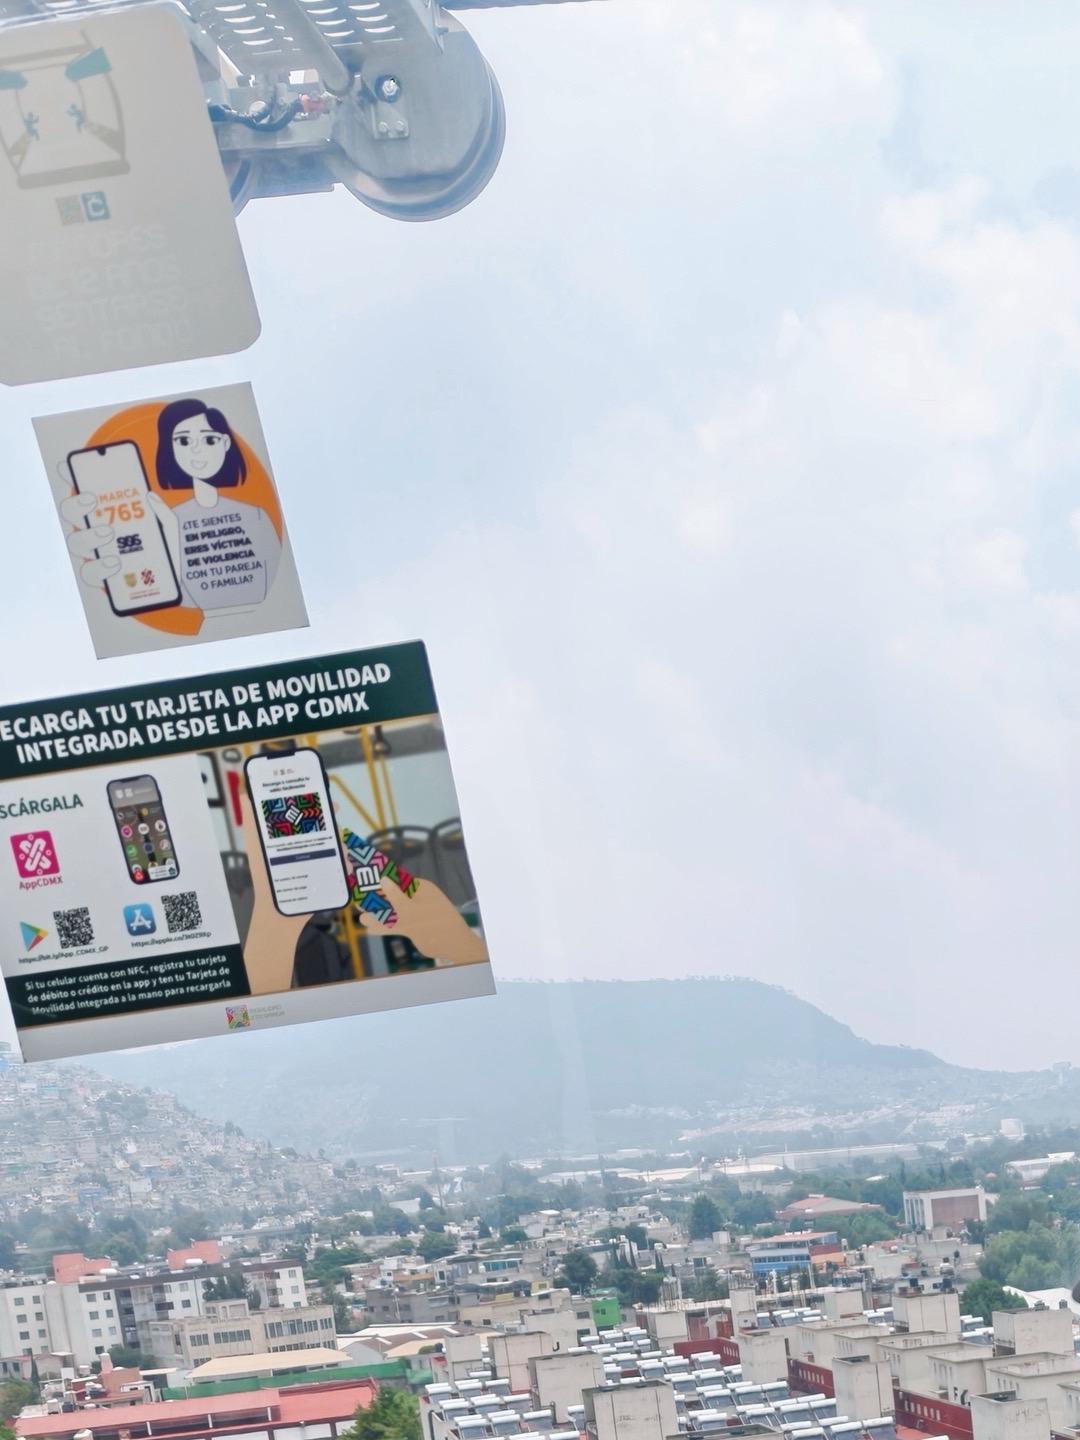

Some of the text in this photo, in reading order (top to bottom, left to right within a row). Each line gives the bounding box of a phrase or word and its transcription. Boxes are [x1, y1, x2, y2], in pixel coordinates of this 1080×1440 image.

[97, 487, 140, 503] MARCA
[183, 513, 242, 531] ¿TE SIENTES
[185, 526, 245, 542] EN PELIGRO,
[184, 537, 252, 555] ERES VÍCTIMA
[187, 549, 255, 567] DE VIOLENCIA
[186, 560, 262, 580] CON TU PAREJA
[200, 574, 254, 591] O FAMILIA?
[0, 663, 391, 742] ECARGA TU TARJETA DE MOVILIDAD
[16, 691, 370, 764] INTEGRADA DESDE LA APP CDMX
[19, 876, 64, 891] AppCDMX
[25, 954, 227, 991] Si tu celular cuenta con NFC, registra tu tarjeta
[27, 994, 39, 1003] de
[40, 989, 69, 1001] débito
[78, 985, 109, 996] crédito
[123, 981, 132, 989] la
[133, 979, 150, 988] app
[152, 978, 157, 987] y
[158, 975, 174, 984] ten
[174, 973, 185, 981] tu
[186, 969, 217, 980] Tarjeta
[219, 966, 230, 975] de
[31, 1000, 76, 1015] Movilidad
[77, 995, 119, 1008] Integrada
[127, 993, 136, 1001] la
[138, 990, 163, 1000] mano
[164, 986, 185, 998] para
[186, 979, 231, 992] recargarla
